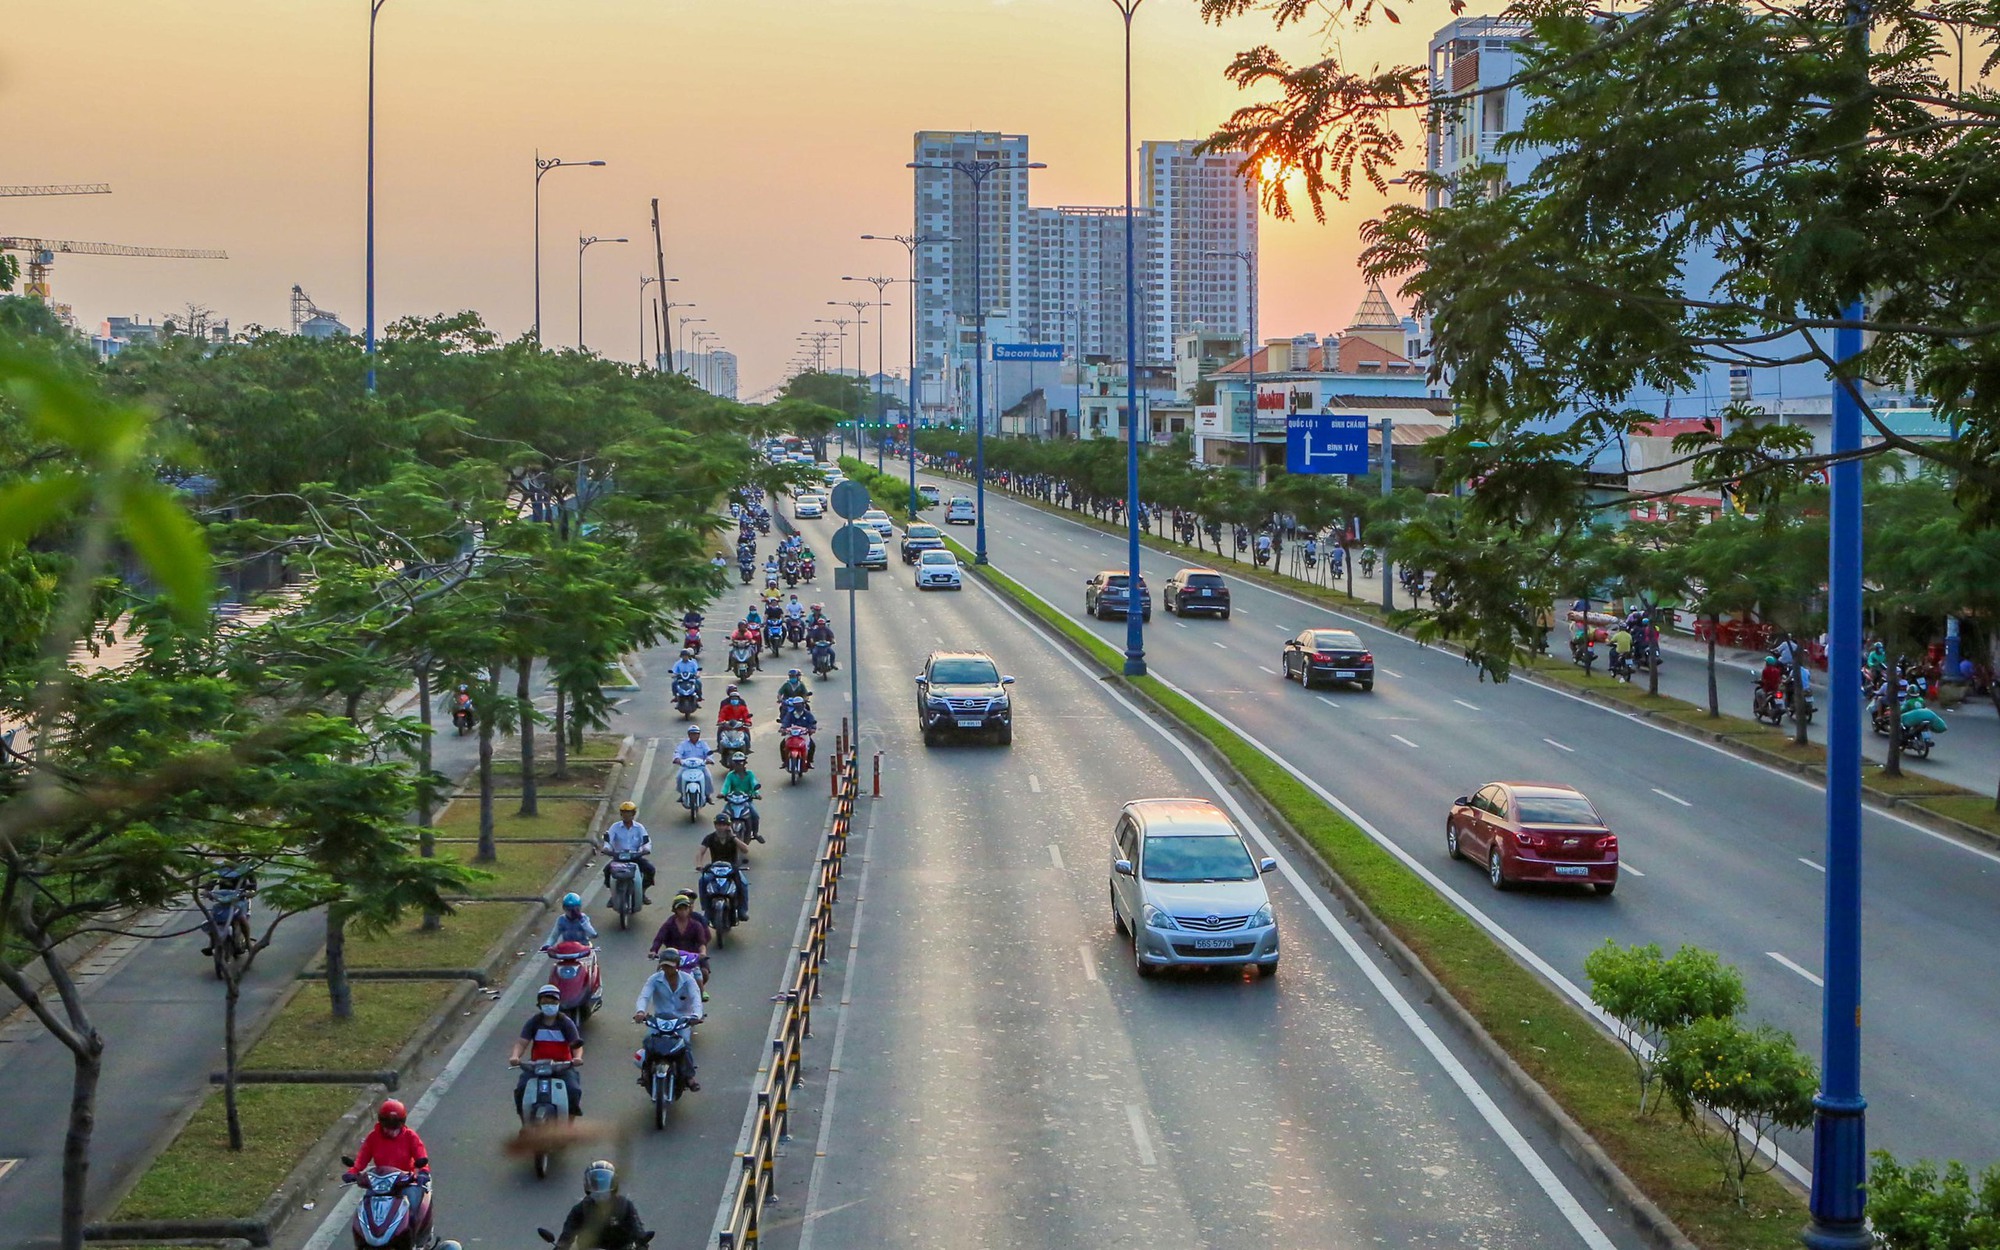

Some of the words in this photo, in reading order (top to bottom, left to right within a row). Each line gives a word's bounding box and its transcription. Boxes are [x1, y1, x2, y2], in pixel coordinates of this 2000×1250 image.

[996, 346, 1059, 358] Sacombank
[1288, 418, 1304, 429] QUỐC
[1305, 419, 1313, 430] LỘ
[1331, 419, 1345, 429] BÌNH
[1346, 419, 1366, 429] CHÁNH
[1327, 442, 1343, 452] BÌNH
[1345, 443, 1359, 452] TÂY
